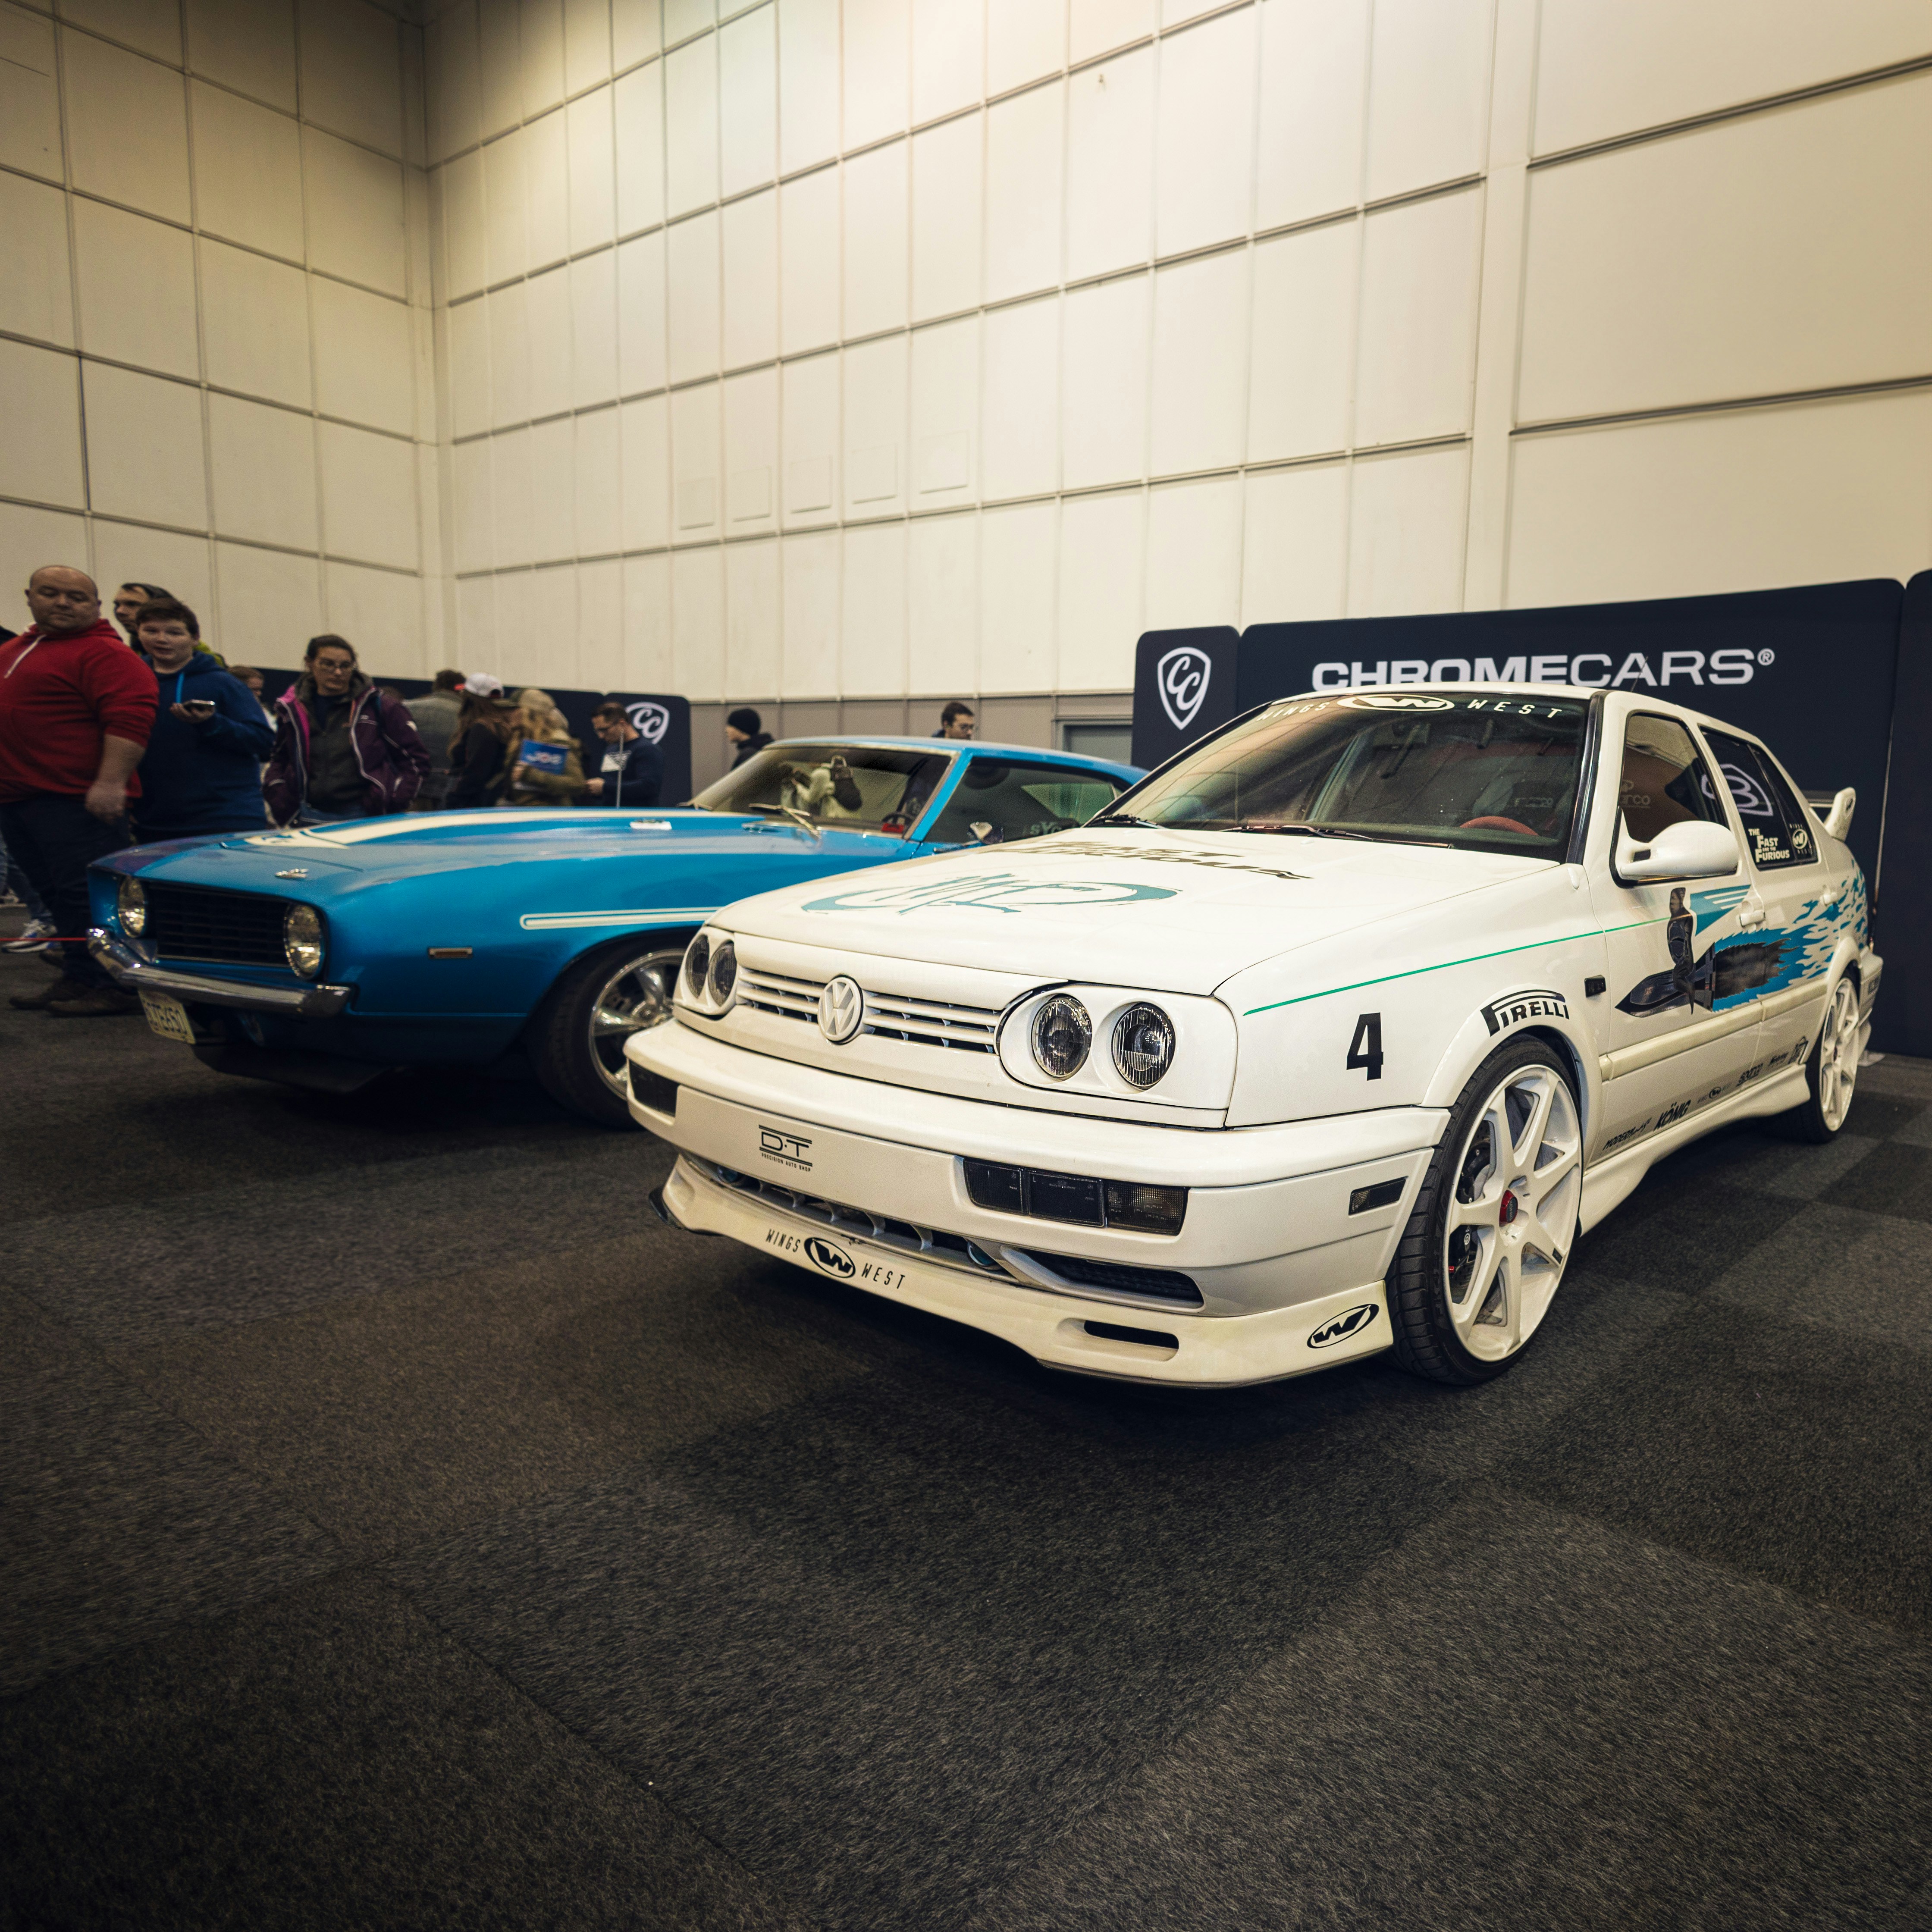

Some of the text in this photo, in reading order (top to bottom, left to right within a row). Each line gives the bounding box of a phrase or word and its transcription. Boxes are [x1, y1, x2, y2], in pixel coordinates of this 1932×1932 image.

[1256, 702, 1330, 721] WINGS
[1468, 699, 1562, 718] WEST
[1748, 828, 1760, 836] THE
[1756, 835, 1778, 849] FAST
[1755, 848, 1790, 862] FURIOUS
[1480, 989, 1570, 1037] PIRELLI
[1346, 1012, 1383, 1081] 4
[761, 1152, 784, 1164] PRECISION
[765, 1228, 801, 1253] WINGS
[861, 1262, 906, 1289] WEST
